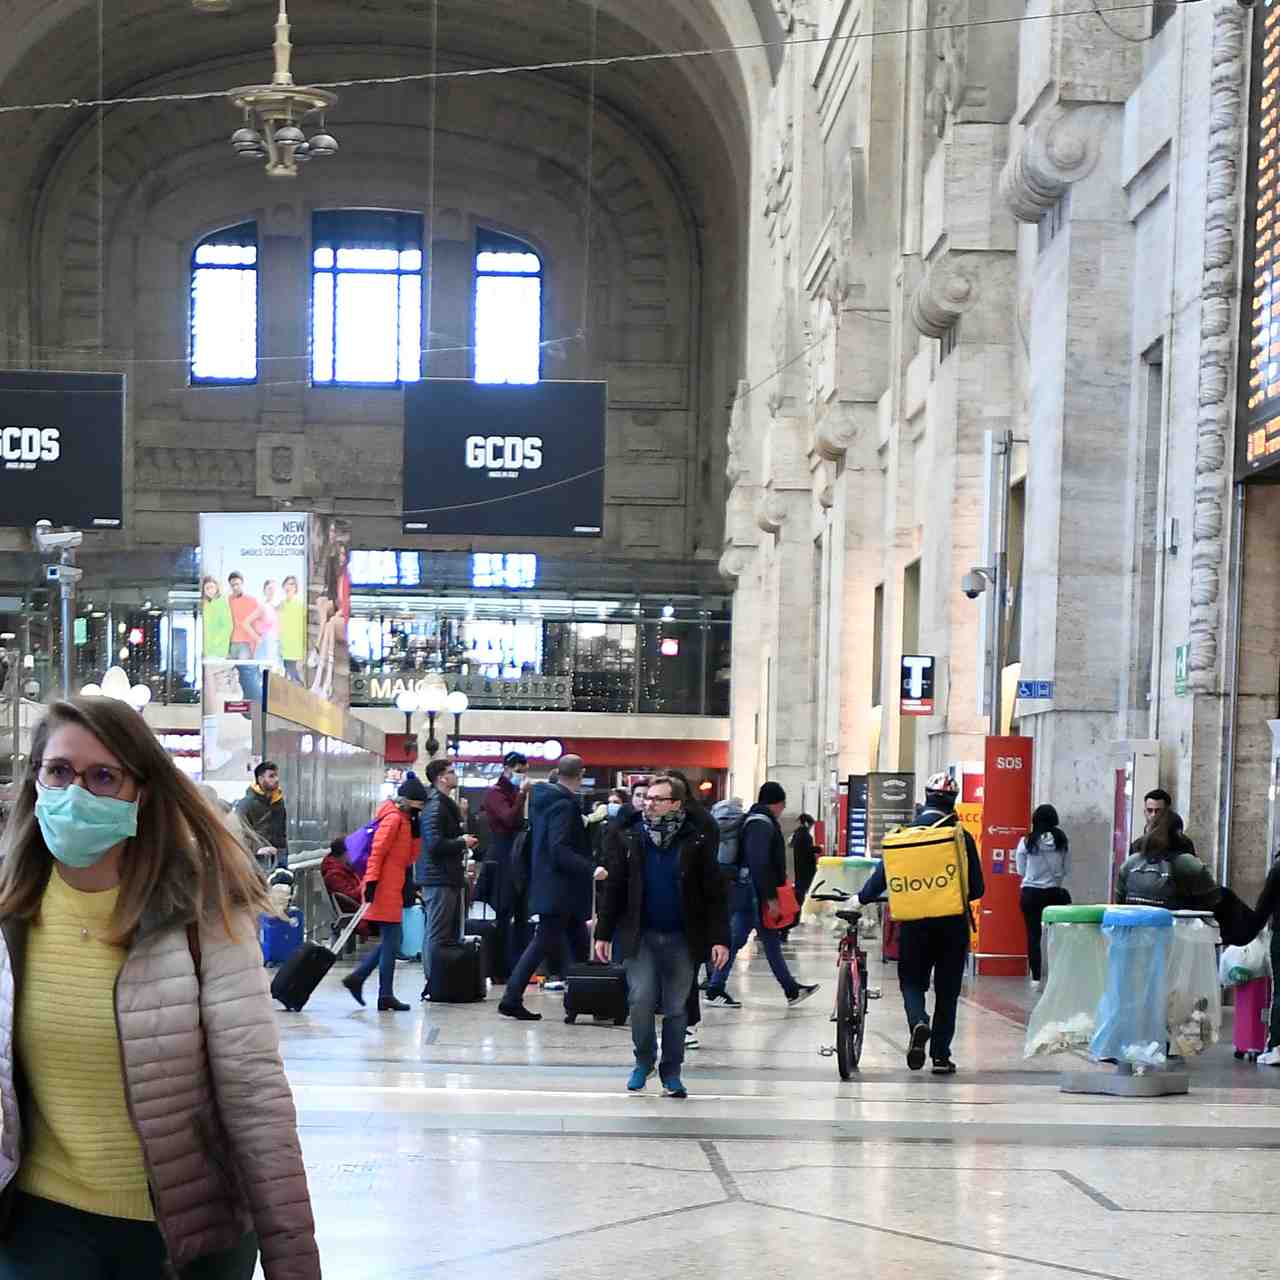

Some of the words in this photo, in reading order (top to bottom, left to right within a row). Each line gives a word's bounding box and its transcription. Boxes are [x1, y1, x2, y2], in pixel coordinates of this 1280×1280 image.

[465, 436, 543, 469] GCDS
[282, 520, 305, 533] NEW
[996, 756, 1023, 769] SOS
[889, 874, 949, 893] Glovo
